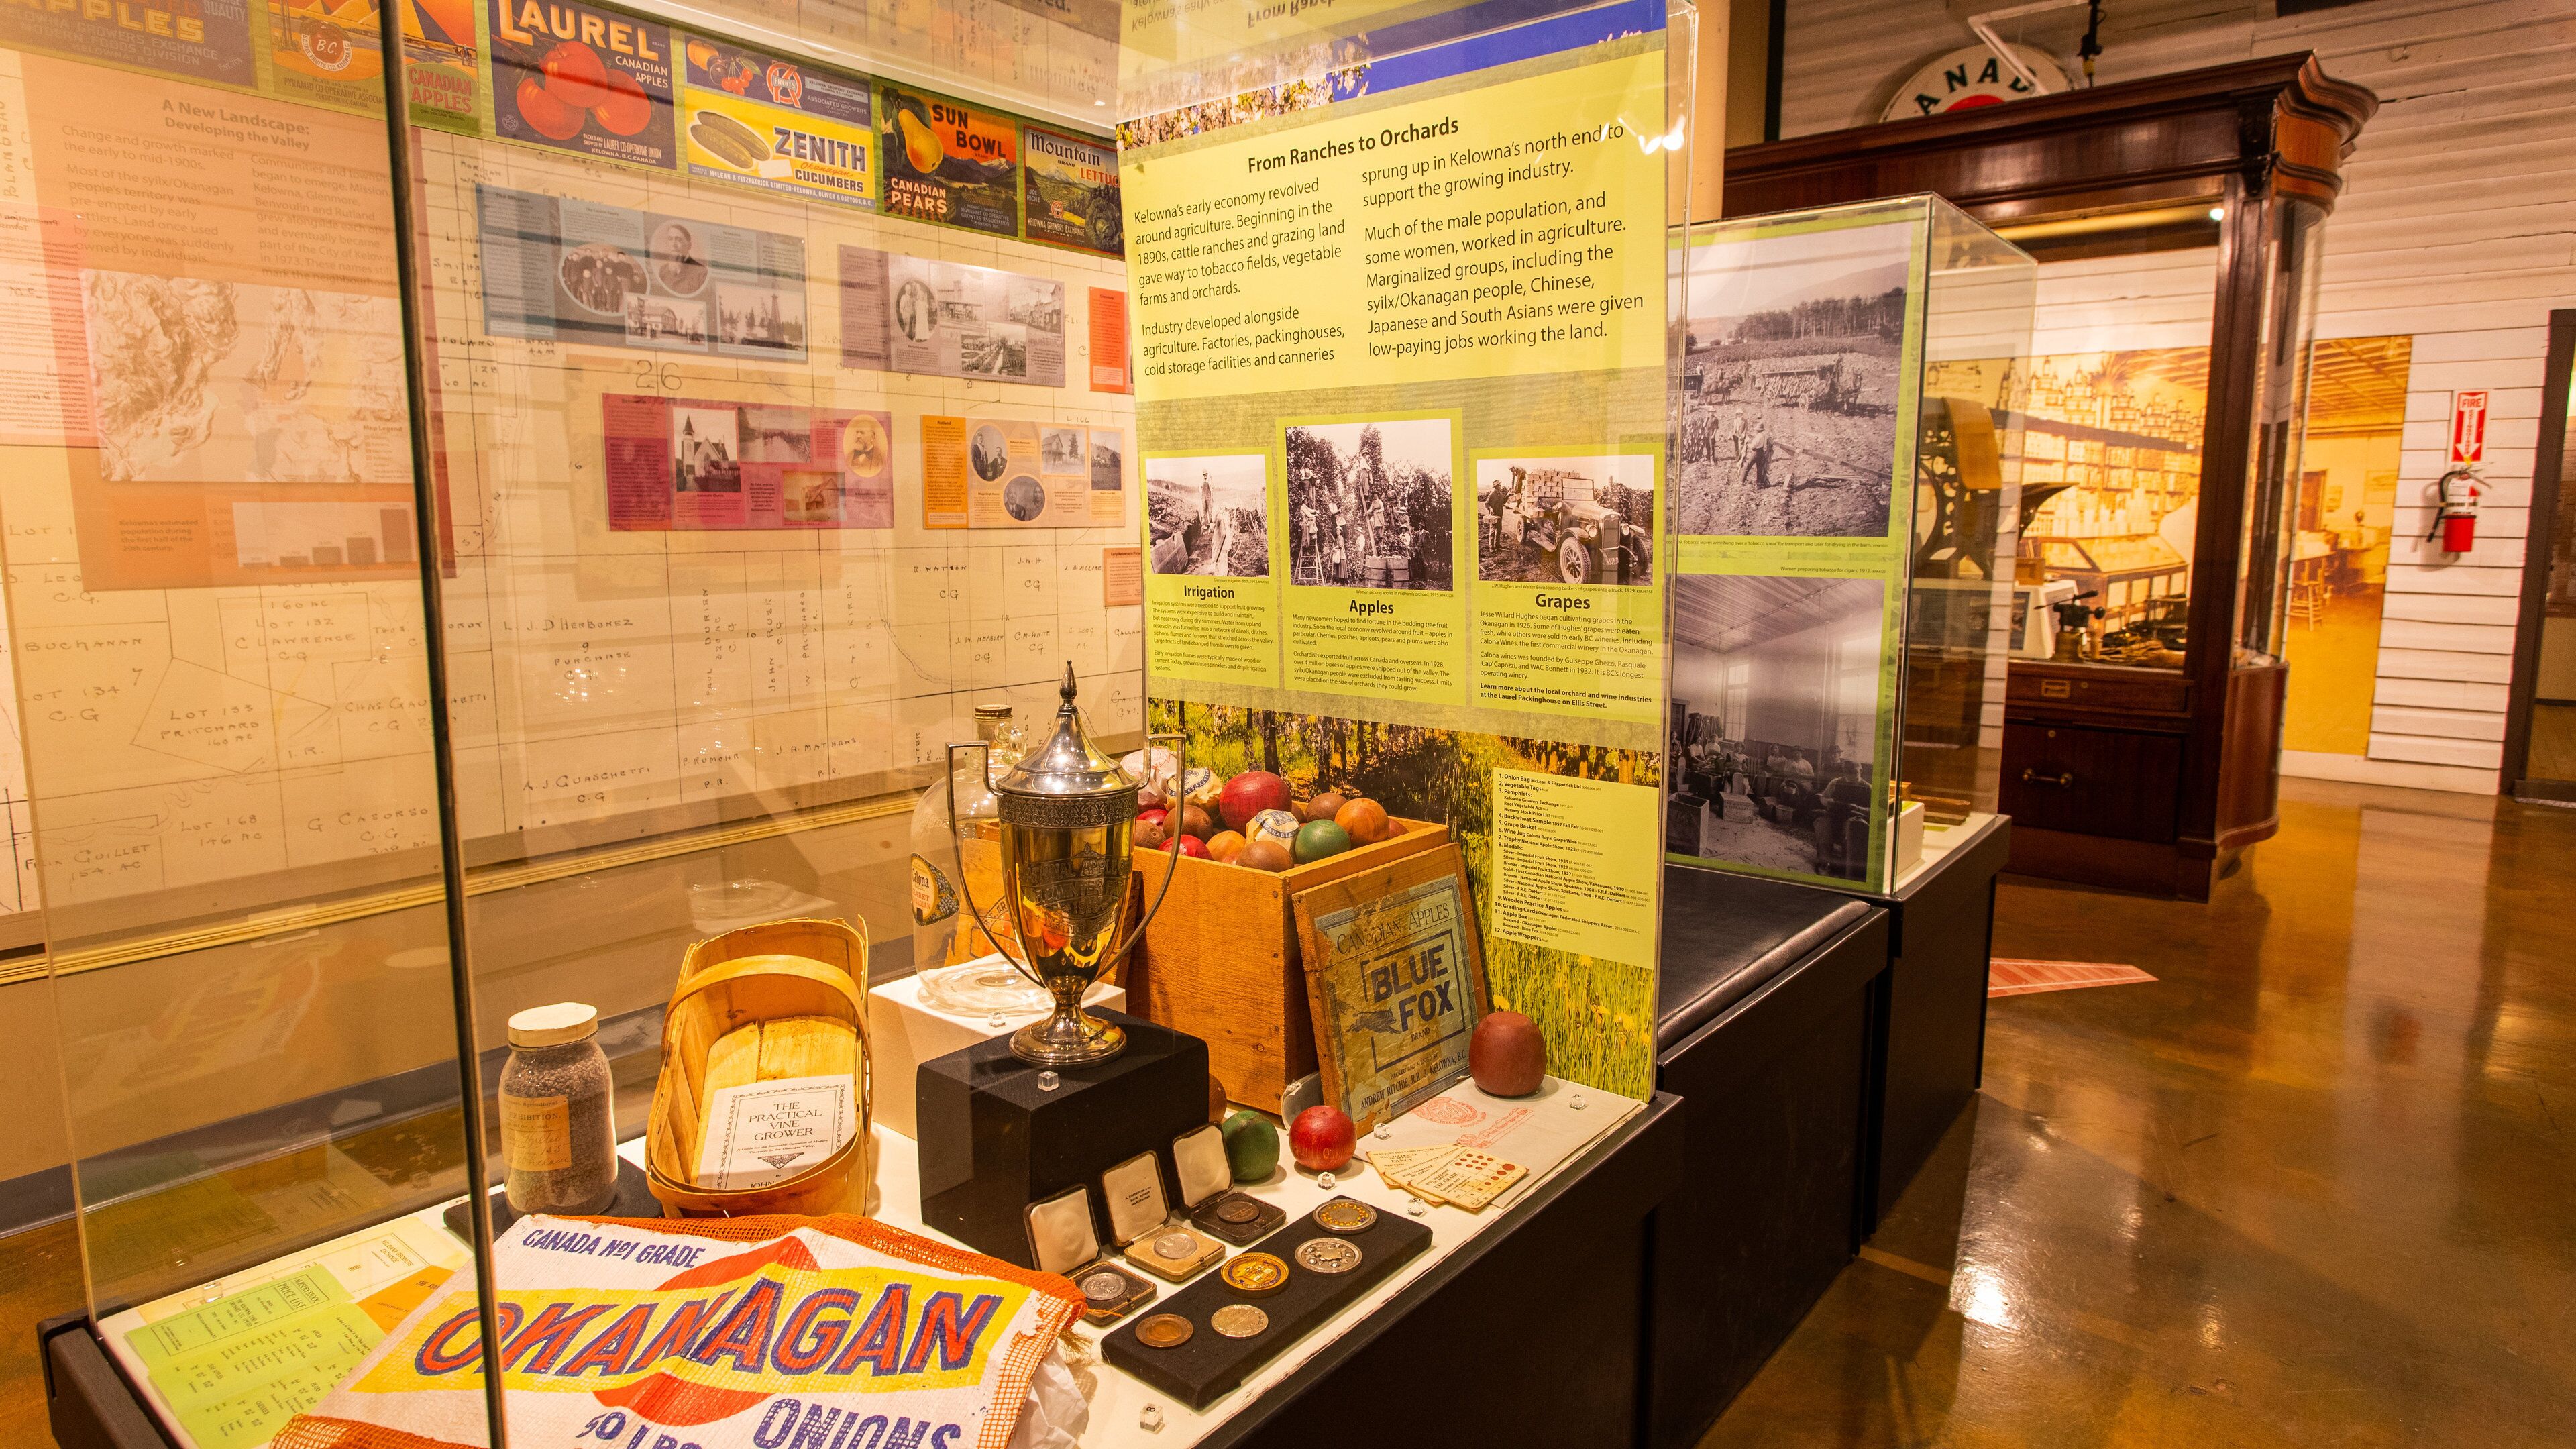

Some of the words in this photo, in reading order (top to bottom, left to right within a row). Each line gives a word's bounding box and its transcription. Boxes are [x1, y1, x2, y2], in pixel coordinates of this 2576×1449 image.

[498, 0, 659, 62] LAUREL
[151, 37, 218, 60] EXCHANGE
[616, 56, 668, 76] CANADIAN
[409, 67, 472, 97] CANADIAN
[635, 72, 668, 89] APPLES
[411, 87, 472, 113] APPLES
[808, 95, 841, 109] ASSOCIATED
[162, 99, 174, 113] A
[178, 103, 215, 121] New
[219, 109, 310, 136] Landscape:
[932, 104, 969, 129] SUN
[165, 117, 245, 142] Developing
[247, 129, 268, 144] the
[271, 135, 309, 152] Valley
[603, 138, 620, 150] LAUREL
[956, 130, 1006, 158] BOWL
[1248, 156, 1286, 174] From
[1290, 140, 1354, 165] Ranches
[1358, 136, 1375, 151] to
[1380, 116, 1458, 147] Orchards
[633, 155, 657, 164] CANADA
[773, 126, 866, 172] ZENITH
[1030, 131, 1100, 166] Mountain
[1362, 165, 1407, 186] sprung
[1412, 161, 1430, 176] up
[1434, 156, 1446, 170] in
[1450, 141, 1520, 167] Kelowna’s
[1525, 131, 1567, 154] north
[1572, 124, 1601, 146] end
[1608, 125, 1623, 140] to
[795, 169, 864, 193] CUCUMBERS
[800, 162, 854, 177] Okanagan
[737, 175, 769, 188] FITZPATRICK
[818, 189, 835, 200] OLIVER
[891, 177, 946, 198] CANADIAN
[1363, 185, 1415, 208] support
[1418, 181, 1441, 197] the
[1444, 173, 1503, 197] growing
[1509, 161, 1574, 182] industry.
[892, 191, 947, 213] PEARS
[1365, 223, 1401, 241] Much
[1405, 219, 1418, 235] of
[1421, 217, 1444, 233] the
[1448, 211, 1481, 229] male
[1486, 201, 1572, 228] population,
[1576, 191, 1605, 211] and
[1065, 225, 1085, 237] EXCHANGE
[1366, 250, 1400, 265] some
[1403, 243, 1458, 260] women,
[1462, 229, 1515, 252] worked
[1521, 231, 1533, 244] in
[1538, 219, 1626, 245] agriculture.
[1366, 263, 1450, 288] Marginalized
[1455, 260, 1508, 281] groups,
[1512, 249, 1582, 270] including
[1587, 244, 1613, 261] the
[1367, 290, 1468, 314] syilx/Okanagan
[1473, 280, 1526, 303] people,
[1531, 276, 1595, 292] Chinese,
[1368, 318, 1428, 336] Japanese
[1432, 311, 1456, 327] and
[1461, 306, 1502, 325] South
[1507, 304, 1553, 320] Asians
[1558, 301, 1595, 315] were
[1600, 296, 1643, 315] given
[1369, 338, 1441, 358] low-paying
[1444, 334, 1474, 354] jobs
[1477, 329, 1536, 347] working
[1540, 325, 1565, 341] the
[1570, 321, 1607, 339] land.
[635, 359, 683, 391] 26
[2462, 398, 2482, 408] FIRE
[1184, 585, 1234, 600] Irrigation
[1536, 593, 1590, 612] Grapes
[1349, 600, 1394, 616] Apples
[1515, 685, 1533, 693] about
[1618, 694, 1652, 703] industries
[1518, 695, 1561, 704] Packinghouse
[1408, 903, 1450, 932] APPLES
[1371, 943, 1448, 1004] BLUE
[1398, 981, 1454, 1032] FOX
[1411, 1027, 1430, 1042] BRAND
[773, 1102, 800, 1111] THE
[1360, 1087, 1385, 1110] ANDREW
[1387, 1077, 1409, 1097] RITCHIE,
[749, 1109, 822, 1123] PRACTICAL
[769, 1120, 800, 1129] VINE
[754, 1128, 814, 1141] GROWER
[522, 1229, 602, 1258] CANADA
[636, 1244, 706, 1269] GRADE
[277, 1283, 296, 1298] PRICE
[289, 1298, 306, 1309] LIST
[415, 1278, 1003, 1377] OKANAGAN
[576, 1411, 626, 1440] 50
